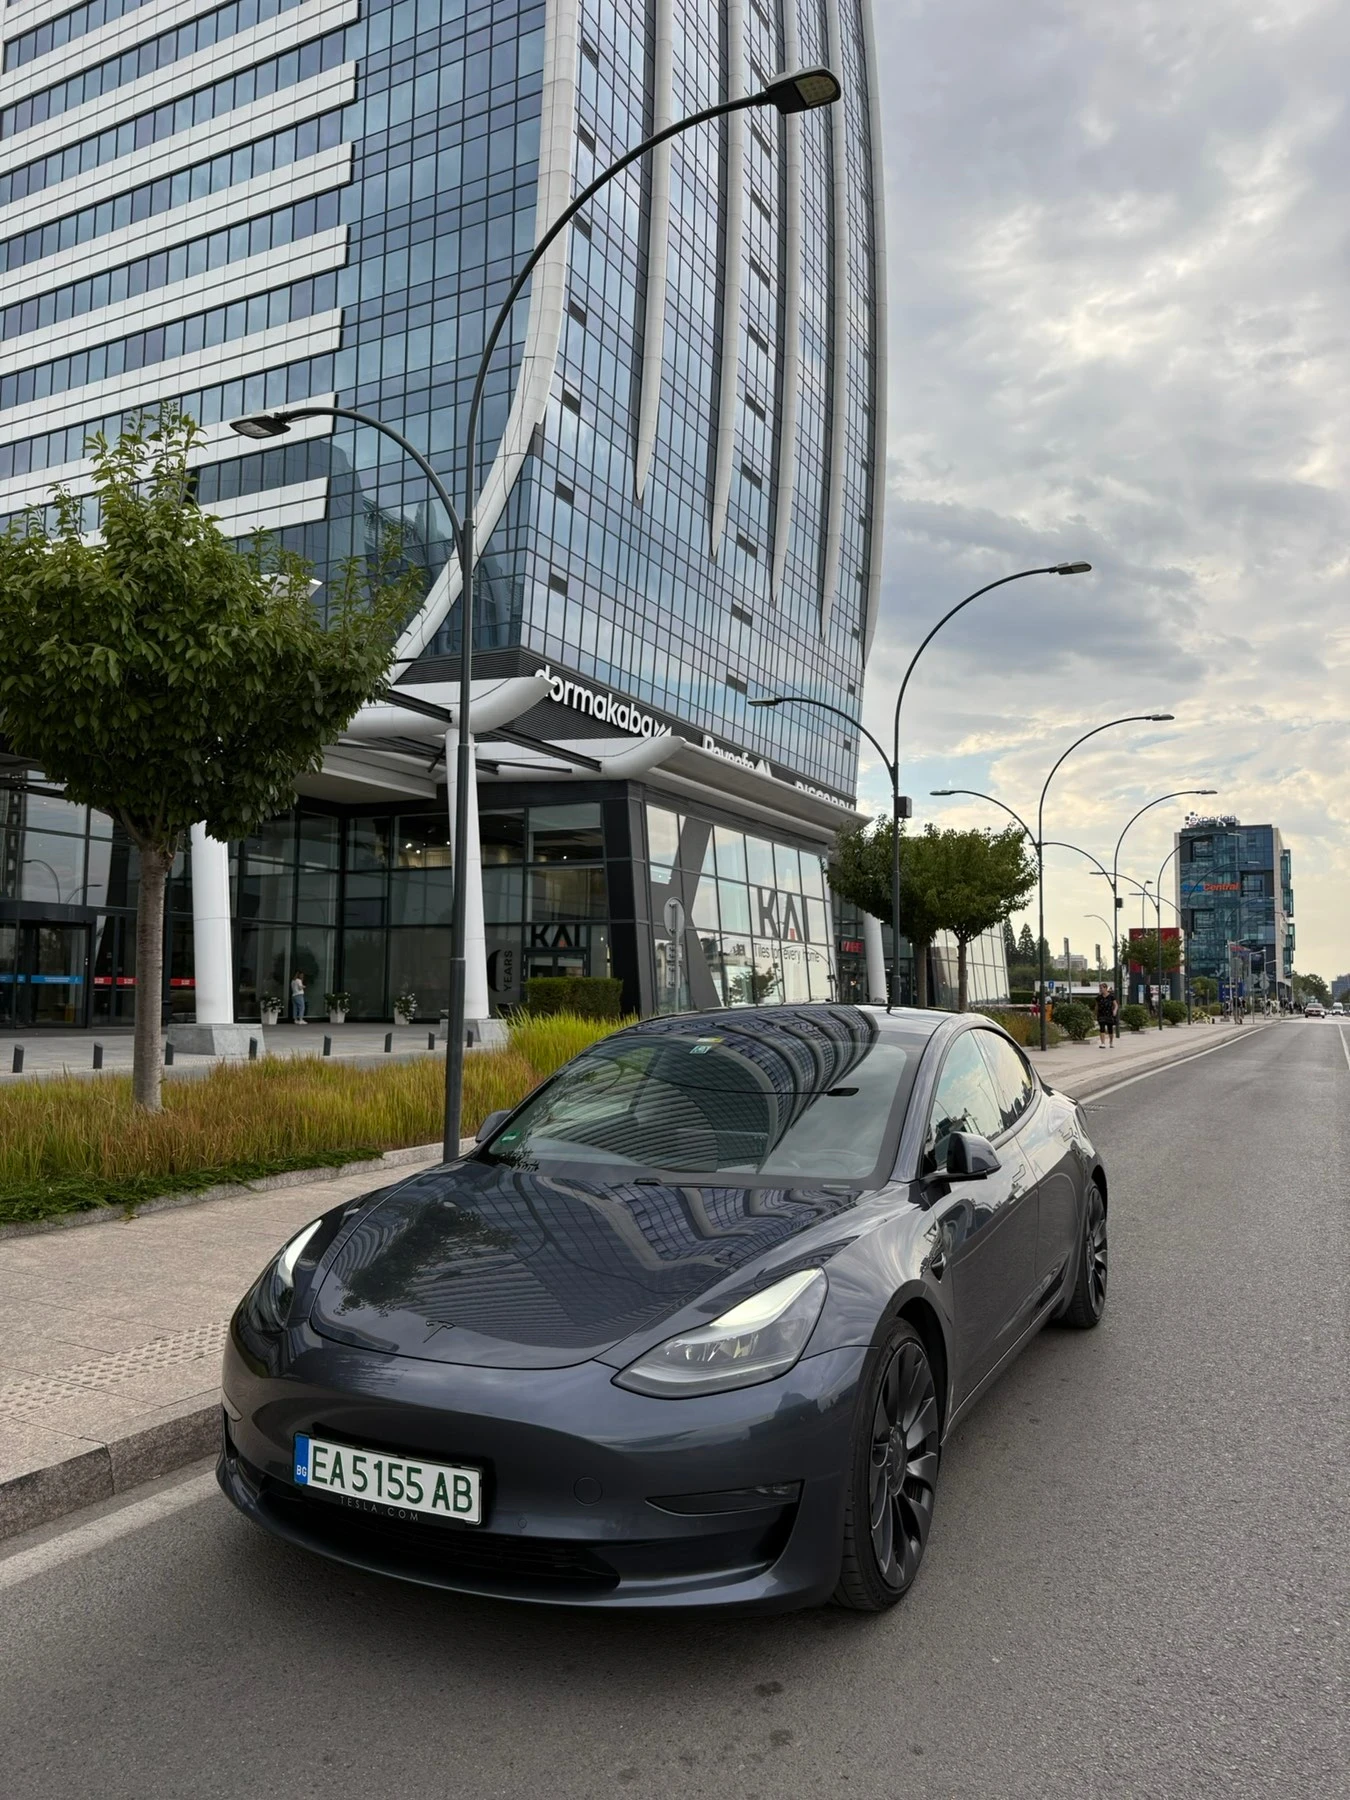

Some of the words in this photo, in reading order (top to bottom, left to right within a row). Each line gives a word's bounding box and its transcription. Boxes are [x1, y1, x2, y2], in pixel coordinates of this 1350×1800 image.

[535, 665, 653, 738] dormakaba
[756, 887, 811, 943] KAI
[530, 924, 581, 948] KAI
[753, 942, 770, 959] Tiles
[783, 948, 801, 965] every
[503, 950, 513, 992] YEARS
[296, 1464, 307, 1477] BG
[312, 1445, 346, 1489] EA
[352, 1455, 424, 1504] 5155
[431, 1471, 473, 1513] AB
[340, 1496, 419, 1521] TESLA.COM
